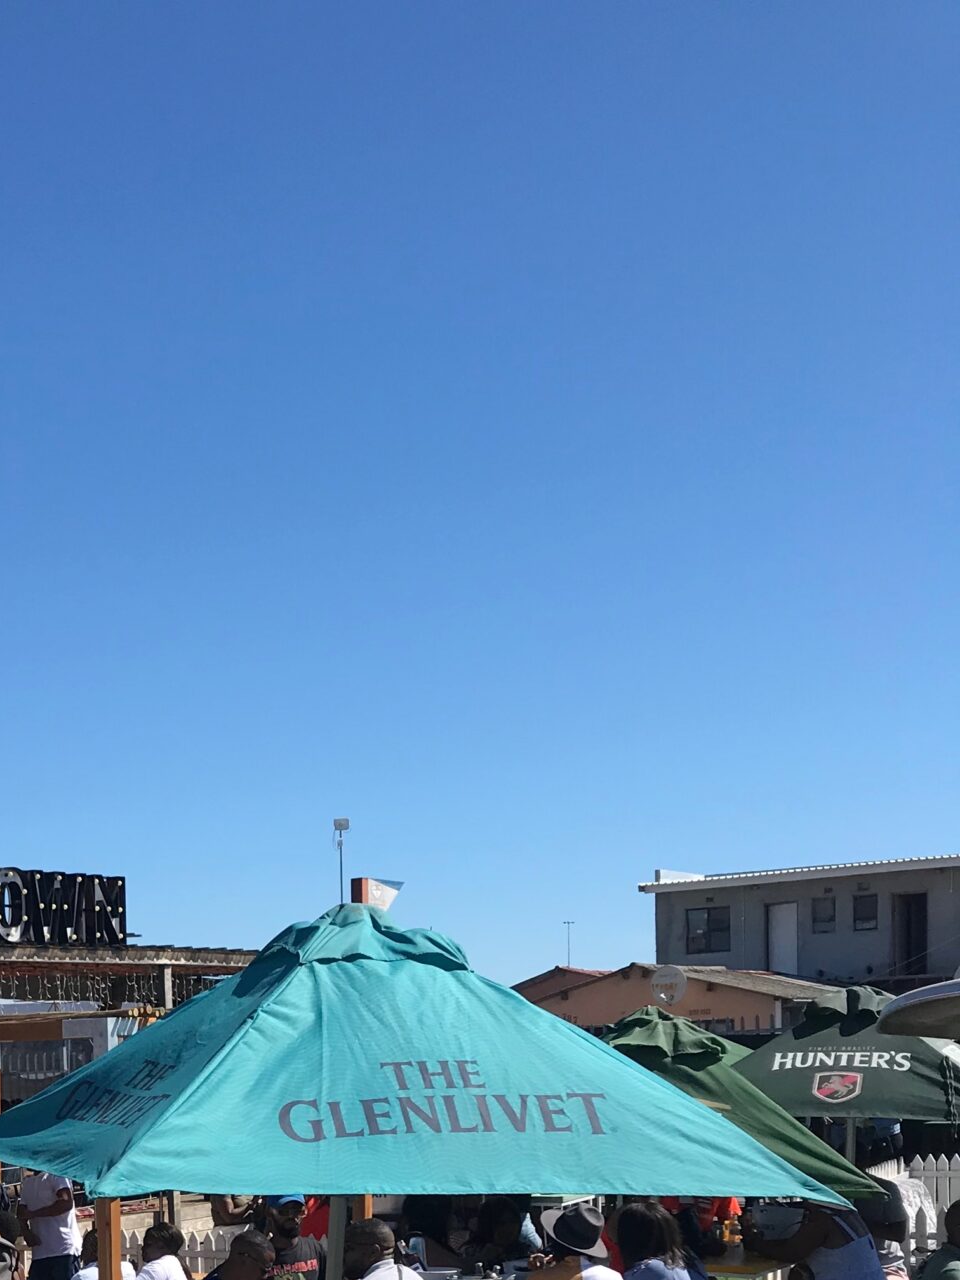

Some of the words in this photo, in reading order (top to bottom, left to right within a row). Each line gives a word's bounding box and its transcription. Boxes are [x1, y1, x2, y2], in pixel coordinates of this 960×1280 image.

[125, 1058, 177, 1091] THE
[379, 1059, 486, 1091] THE
[771, 1050, 912, 1072] HUNTER'S
[55, 1079, 172, 1129] GLENLIVET
[277, 1092, 608, 1144] GLENLIVET
